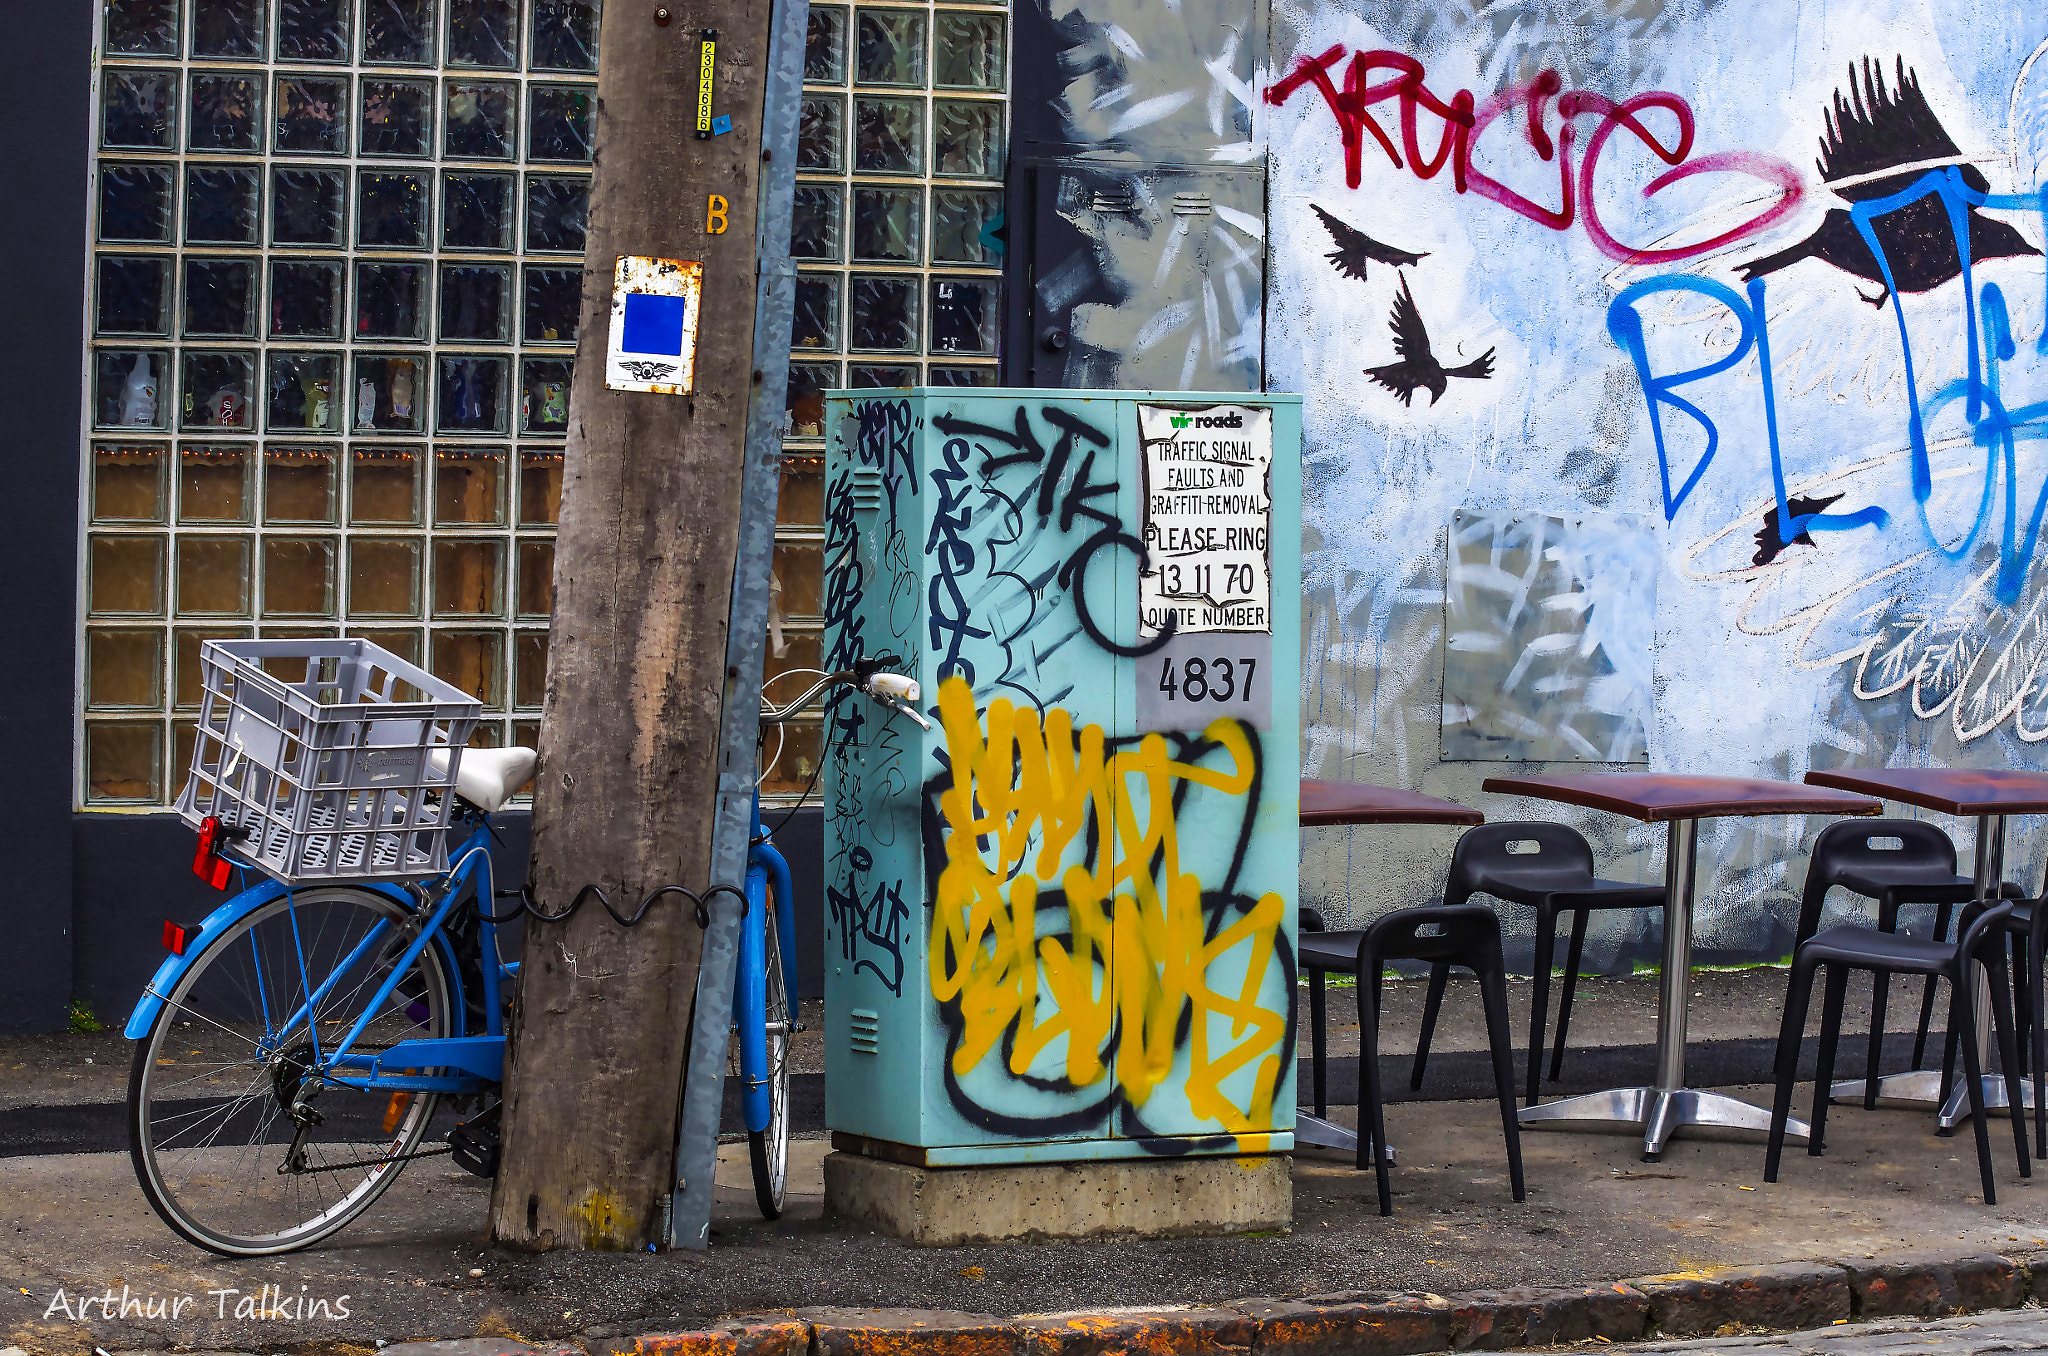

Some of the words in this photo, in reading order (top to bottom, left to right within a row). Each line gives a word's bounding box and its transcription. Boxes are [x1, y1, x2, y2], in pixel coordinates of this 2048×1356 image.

[700, 42, 712, 130] 2304686
[706, 194, 729, 235] B
[1158, 441, 1207, 461] TRAFFIC
[1212, 440, 1255, 461] SIGNAL
[1168, 468, 1214, 487] FAULTS
[1220, 468, 1244, 487] AND
[1151, 495, 1202, 515] GRAFFITI
[1207, 494, 1263, 515] REMOVAL
[1146, 527, 1217, 551] PLEASE
[1225, 527, 1265, 551] RING
[1159, 564, 1182, 594] 13
[1195, 564, 1211, 593] 11
[1223, 563, 1254, 594] 70
[1203, 606, 1264, 627] NUMBER
[1159, 657, 1256, 702] 4837
